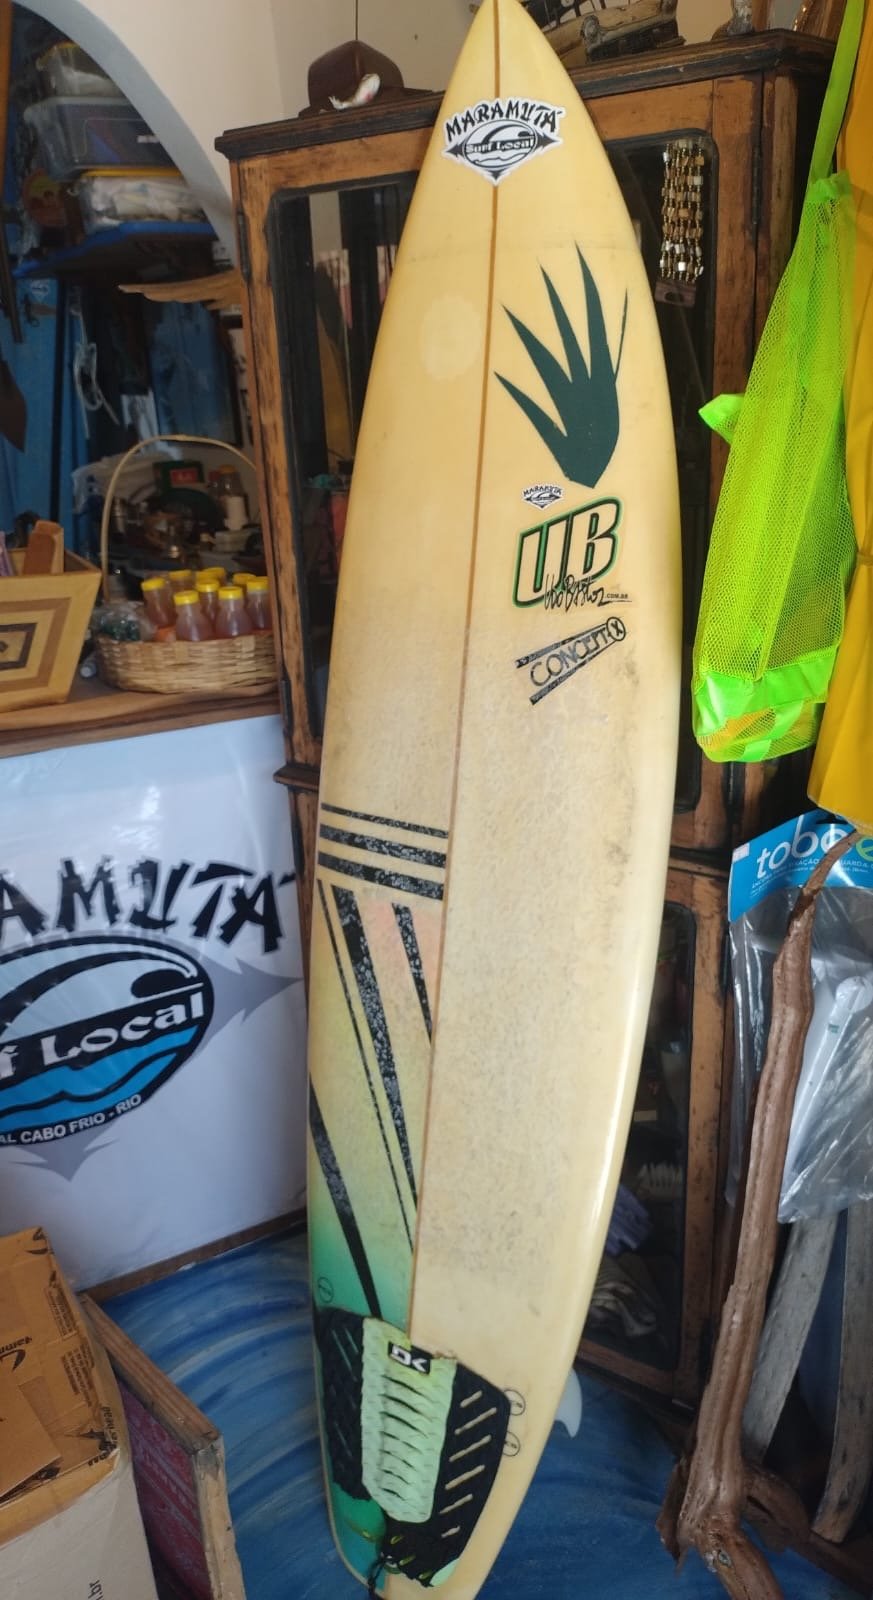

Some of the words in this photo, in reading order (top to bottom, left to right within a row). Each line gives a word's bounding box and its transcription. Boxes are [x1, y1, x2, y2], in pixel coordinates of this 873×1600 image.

[496, 139, 534, 151] Local
[513, 497, 624, 609] UB
[41, 992, 205, 1066] Local
[20, 1124, 66, 1143] CABO
[69, 1112, 105, 1133] FRIO
[115, 1093, 142, 1114] RIO
